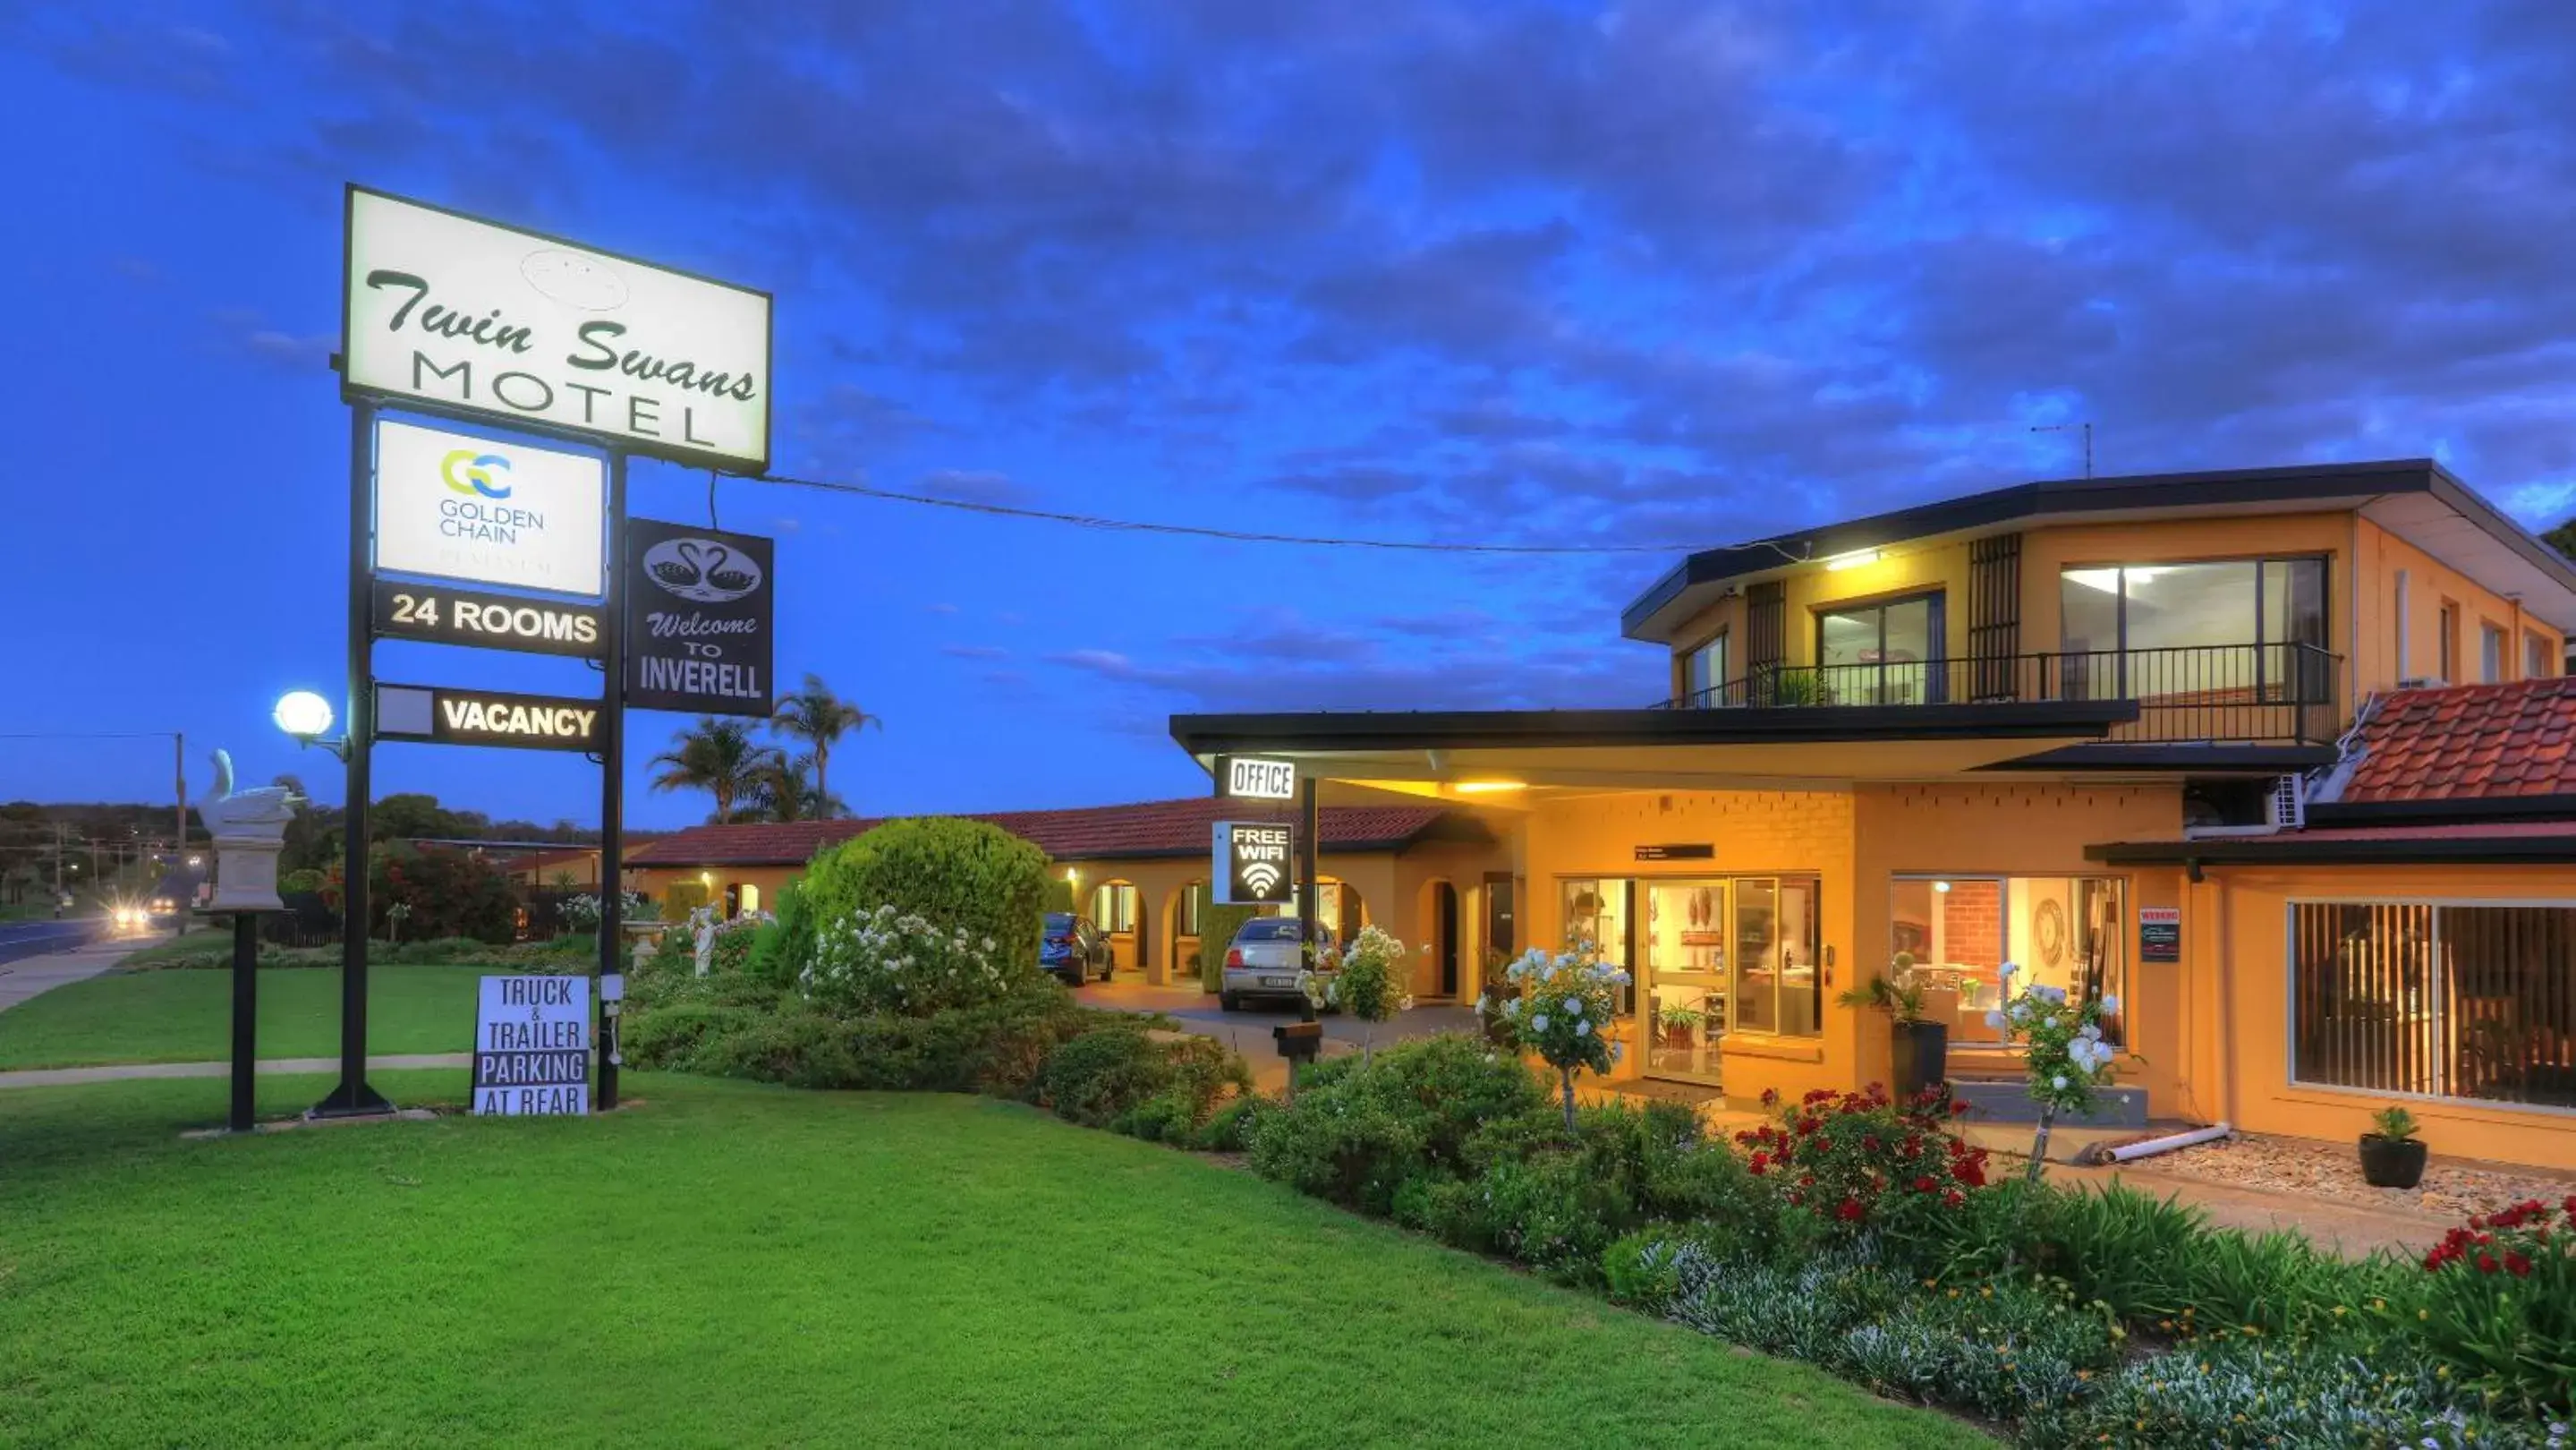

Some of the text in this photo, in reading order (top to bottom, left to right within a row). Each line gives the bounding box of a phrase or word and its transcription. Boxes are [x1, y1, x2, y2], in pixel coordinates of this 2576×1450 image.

[366, 269, 755, 402] Twin Swans
[412, 350, 716, 448] MOTEL
[439, 499, 544, 530] GOLDEN
[439, 519, 516, 544] CHAIN
[391, 593, 599, 643] 24 ROOMS
[645, 612, 757, 637] Welcome
[683, 642, 721, 658] TO
[640, 655, 762, 699] INVERELL
[442, 698, 598, 738] VACANCY
[1234, 763, 1291, 794] OFFICE
[1232, 829, 1288, 845] FREE
[1237, 845, 1284, 860] WIFI
[500, 978, 573, 1005] TRUCK
[531, 1006, 540, 1021] &
[489, 1021, 580, 1050] TRAILER
[480, 1053, 583, 1083] PARKING
[484, 1087, 579, 1115] AT REAR
